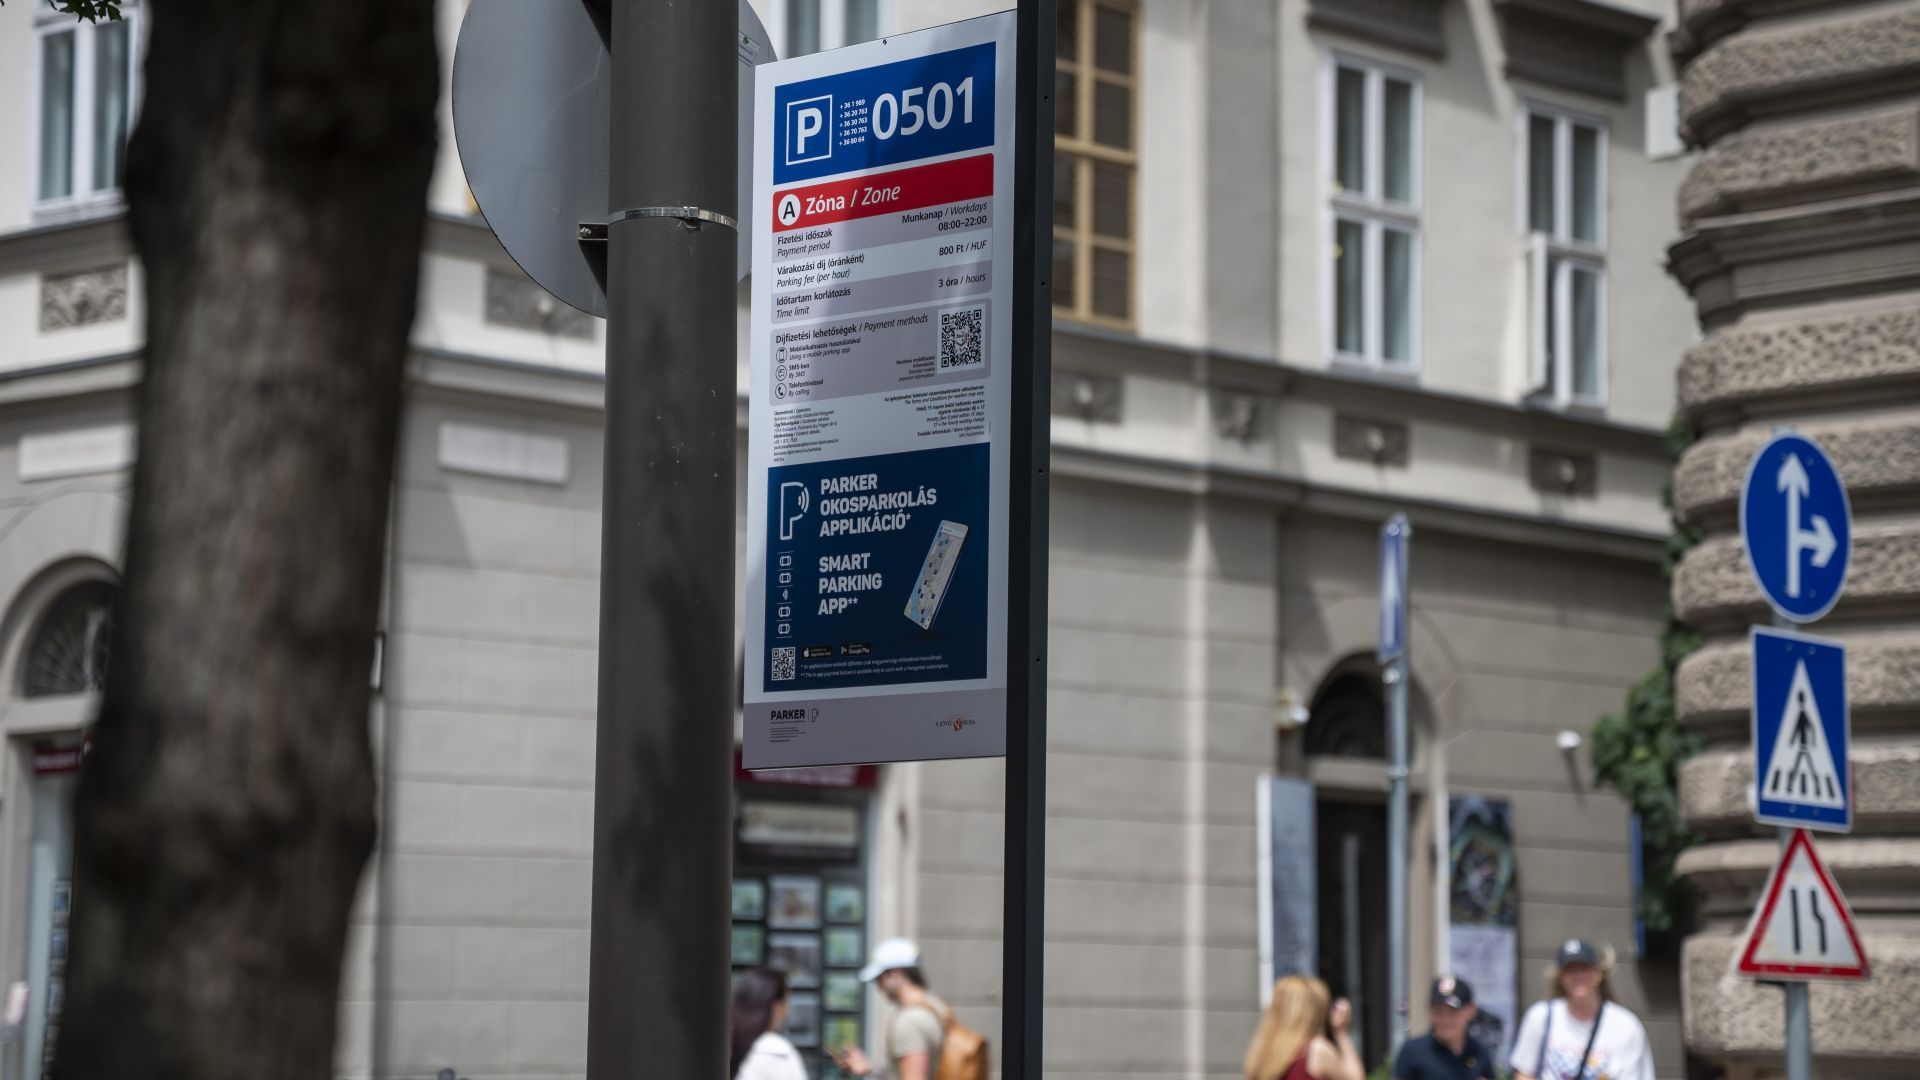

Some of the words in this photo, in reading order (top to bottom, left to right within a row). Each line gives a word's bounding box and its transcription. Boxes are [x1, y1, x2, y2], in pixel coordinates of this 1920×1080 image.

[872, 76, 973, 140] 0501
[797, 107, 823, 154] P
[857, 135, 865, 143] 64
[783, 201, 796, 219] A
[805, 194, 845, 215] Zóna
[851, 189, 858, 207] /
[861, 185, 901, 206] Zone
[902, 210, 943, 224] Munkanap
[950, 202, 987, 216] Workdays
[777, 232, 804, 245] Fizetési
[806, 227, 833, 241] időszak
[777, 244, 807, 258] Payment
[808, 240, 831, 254] period
[939, 245, 954, 256] 800
[956, 244, 964, 253] Ft
[965, 242, 970, 252] /
[971, 240, 988, 251] HUF
[777, 261, 815, 275] Várakozási
[828, 253, 865, 269] (óránként)
[777, 276, 803, 288] Parking
[803, 274, 815, 286] fee
[817, 272, 830, 284] (per
[832, 268, 851, 279] hour)
[938, 279, 944, 288] 3
[945, 276, 958, 287] óra
[966, 274, 987, 284] hours
[776, 294, 812, 306] Időtartam
[814, 286, 851, 300] korlátozás
[777, 309, 793, 318] Time
[794, 305, 810, 316] limit
[813, 324, 857, 339] lehetőségek
[864, 319, 895, 332] Payment
[897, 313, 929, 326] methods
[789, 353, 802, 361] Using
[806, 350, 822, 358] mobile
[823, 348, 841, 357] parking
[789, 363, 810, 371] SMS-ben
[795, 388, 810, 396] calling
[820, 473, 878, 495] PARKER
[820, 485, 937, 516] OKOSPARKOLÁS
[818, 552, 871, 573] SMART
[818, 572, 883, 594] PARKING
[770, 708, 806, 721] PARKER
